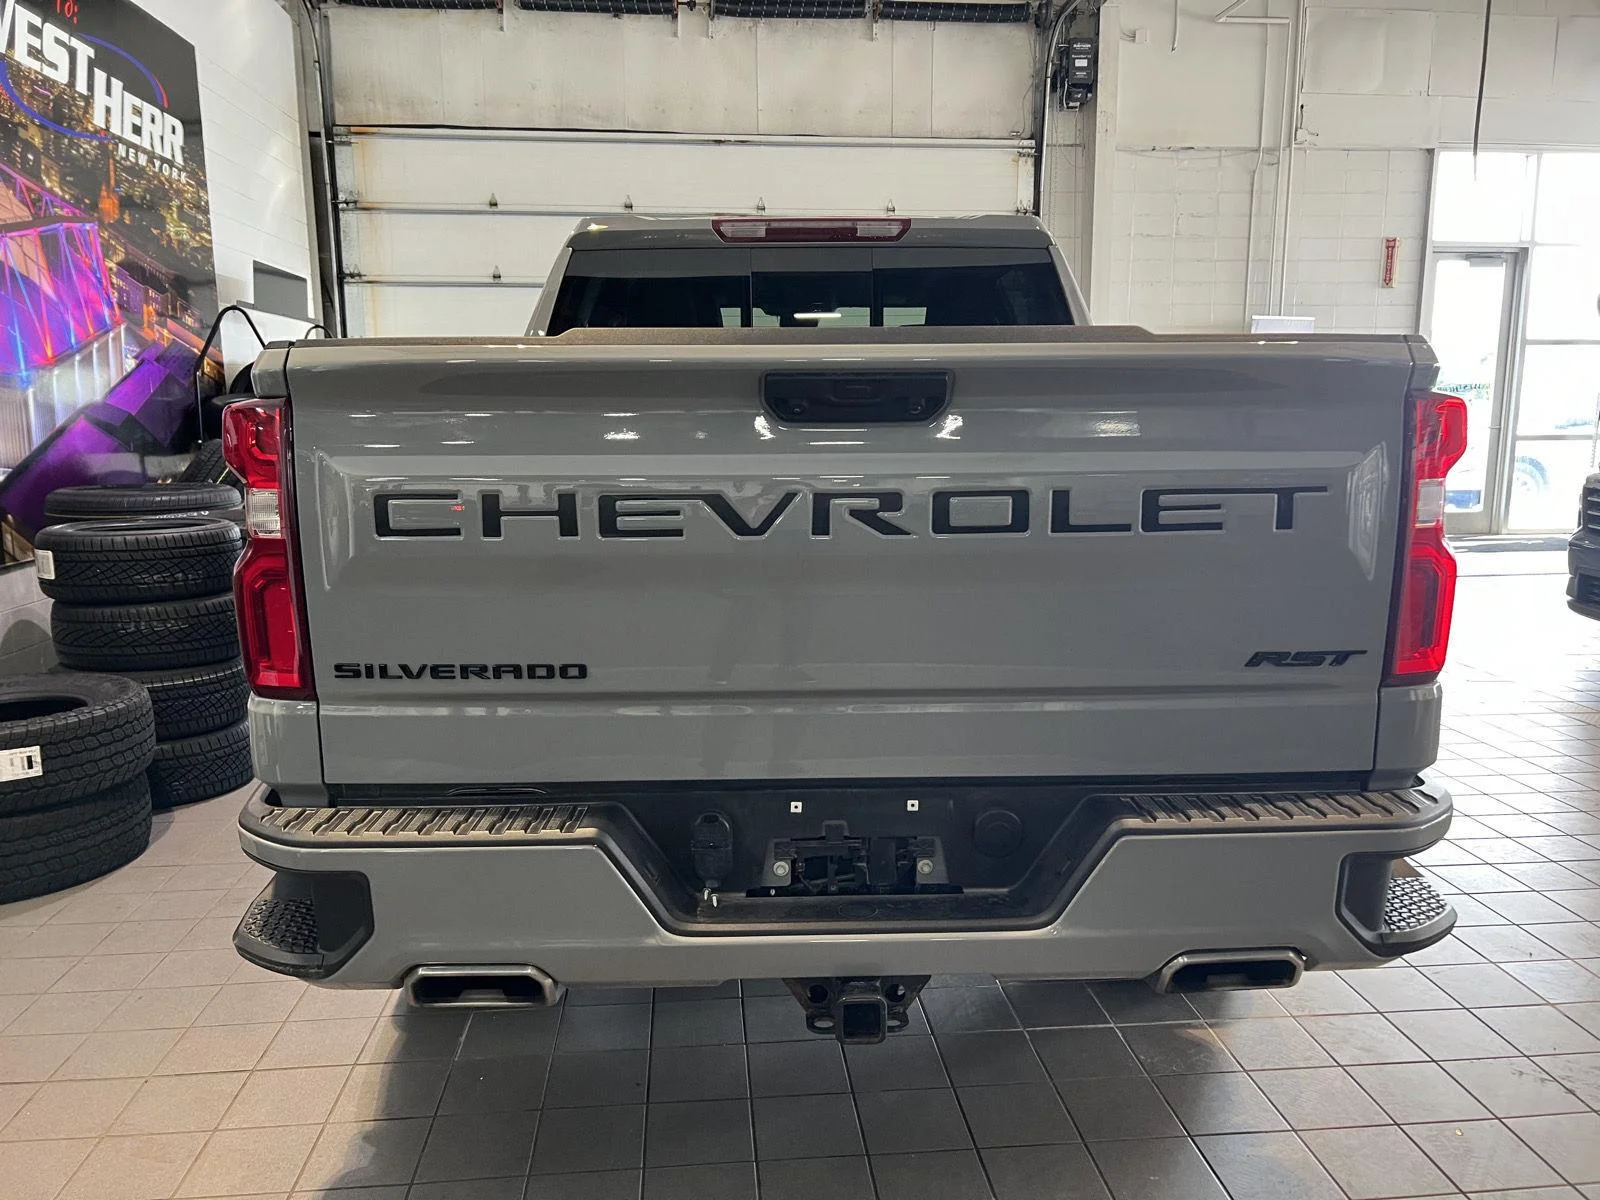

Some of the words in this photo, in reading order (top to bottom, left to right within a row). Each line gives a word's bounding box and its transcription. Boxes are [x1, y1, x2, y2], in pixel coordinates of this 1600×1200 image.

[93, 67, 184, 165] HERR
[118, 143, 148, 166] NEW
[153, 158, 187, 184] YORK
[373, 485, 1328, 538] CHEVROLET
[333, 662, 588, 680] SILVERADO
[1244, 649, 1368, 667] RST
